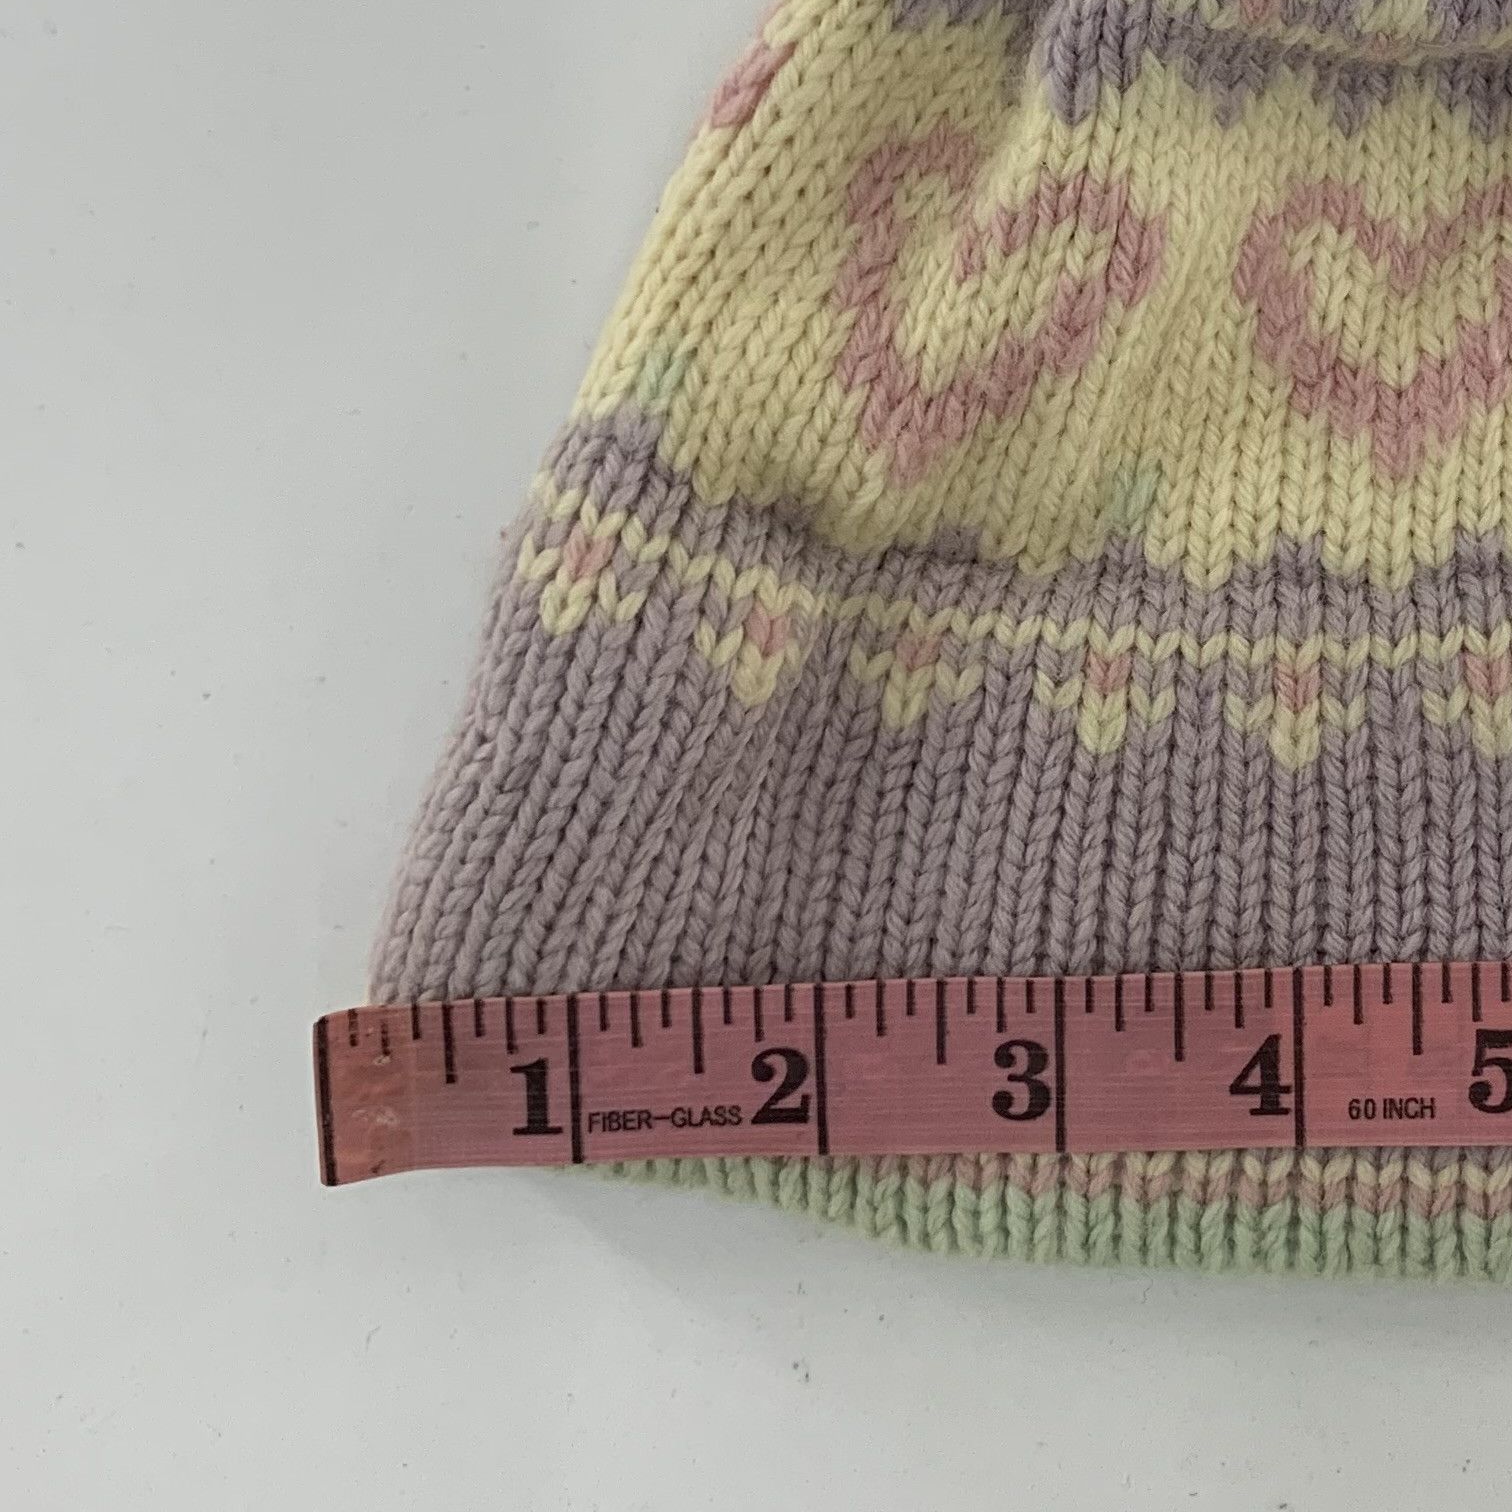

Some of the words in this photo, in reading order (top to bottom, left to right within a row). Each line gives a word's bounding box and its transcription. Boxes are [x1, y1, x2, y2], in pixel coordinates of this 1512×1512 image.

[509, 1057, 564, 1136] 1
[750, 1046, 812, 1125] 2
[990, 1039, 1052, 1121] 3
[1228, 1034, 1293, 1116] 4
[1347, 1098, 1377, 1121] 60
[1381, 1096, 1436, 1121] INCH
[586, 1103, 743, 1133] FIBER-GLASS
